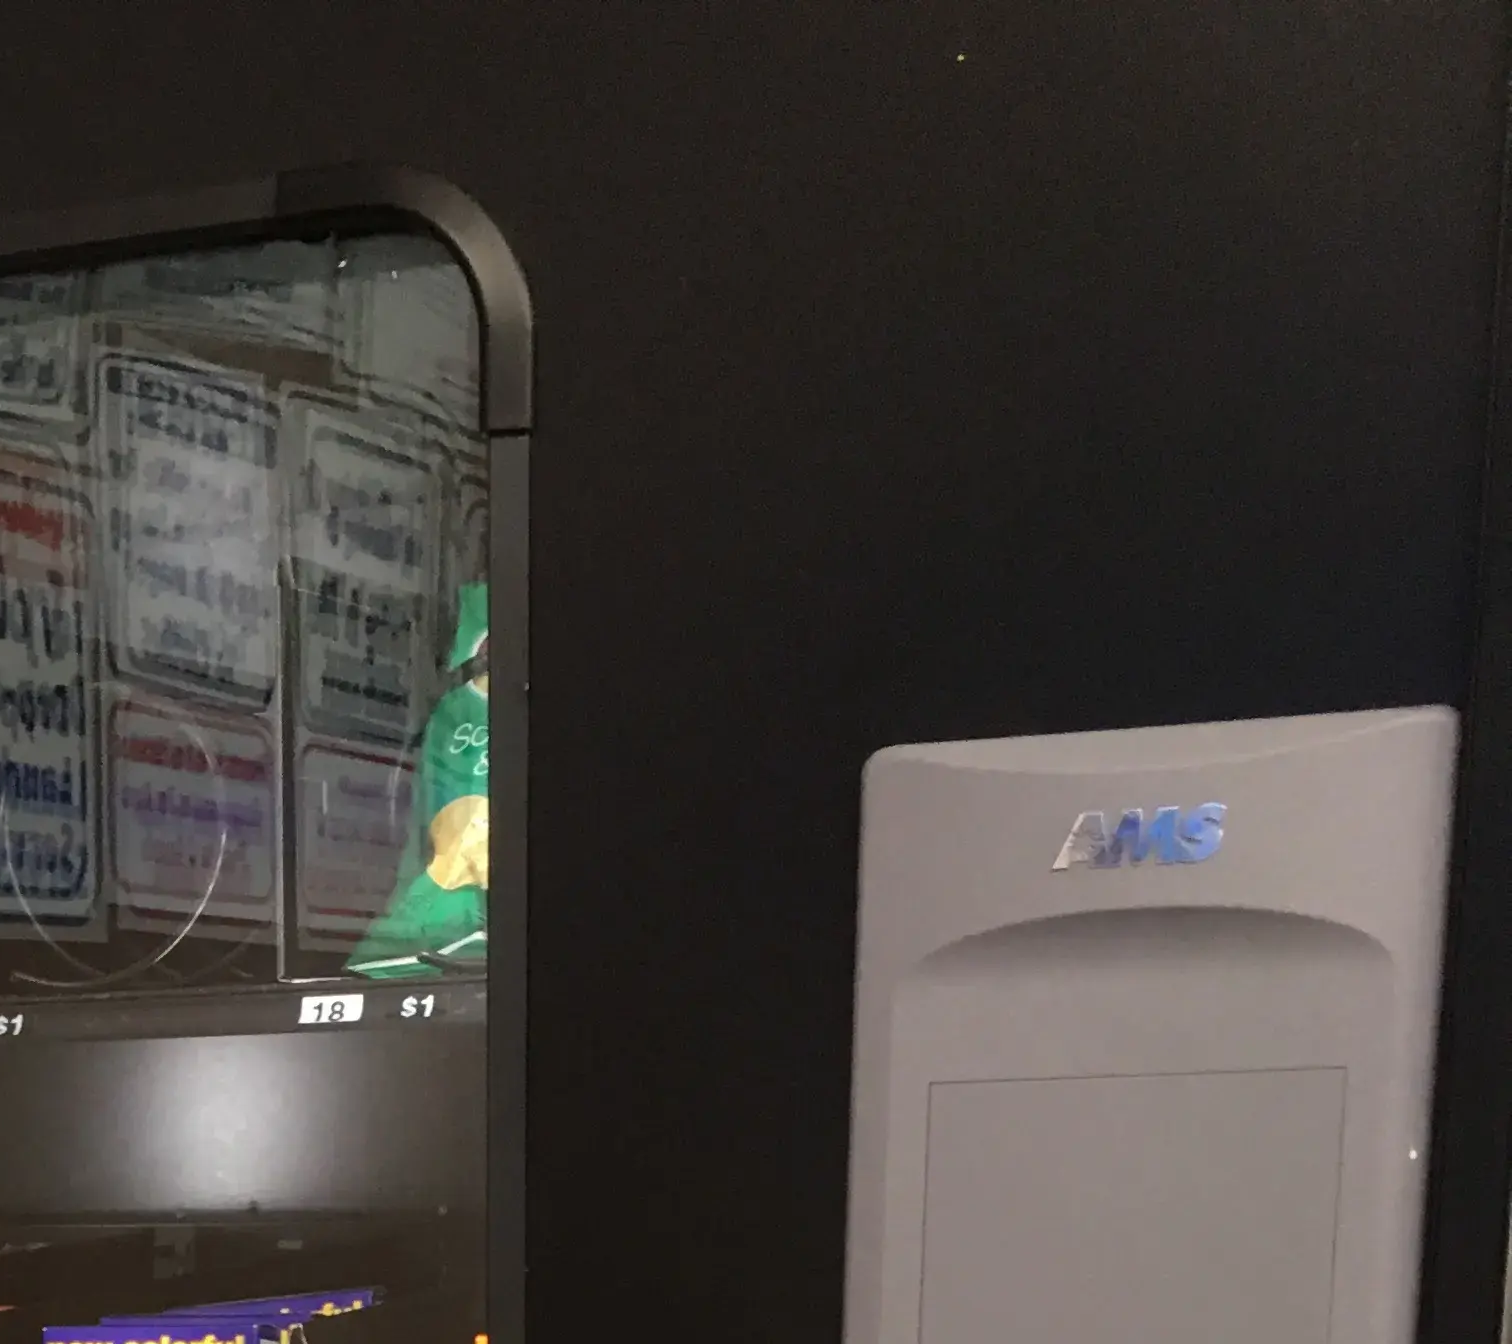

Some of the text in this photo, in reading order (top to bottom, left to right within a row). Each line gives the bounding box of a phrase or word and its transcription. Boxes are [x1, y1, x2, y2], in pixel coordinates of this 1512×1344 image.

[1051, 802, 1227, 872] AMS
[312, 995, 435, 1022] 18 $1
